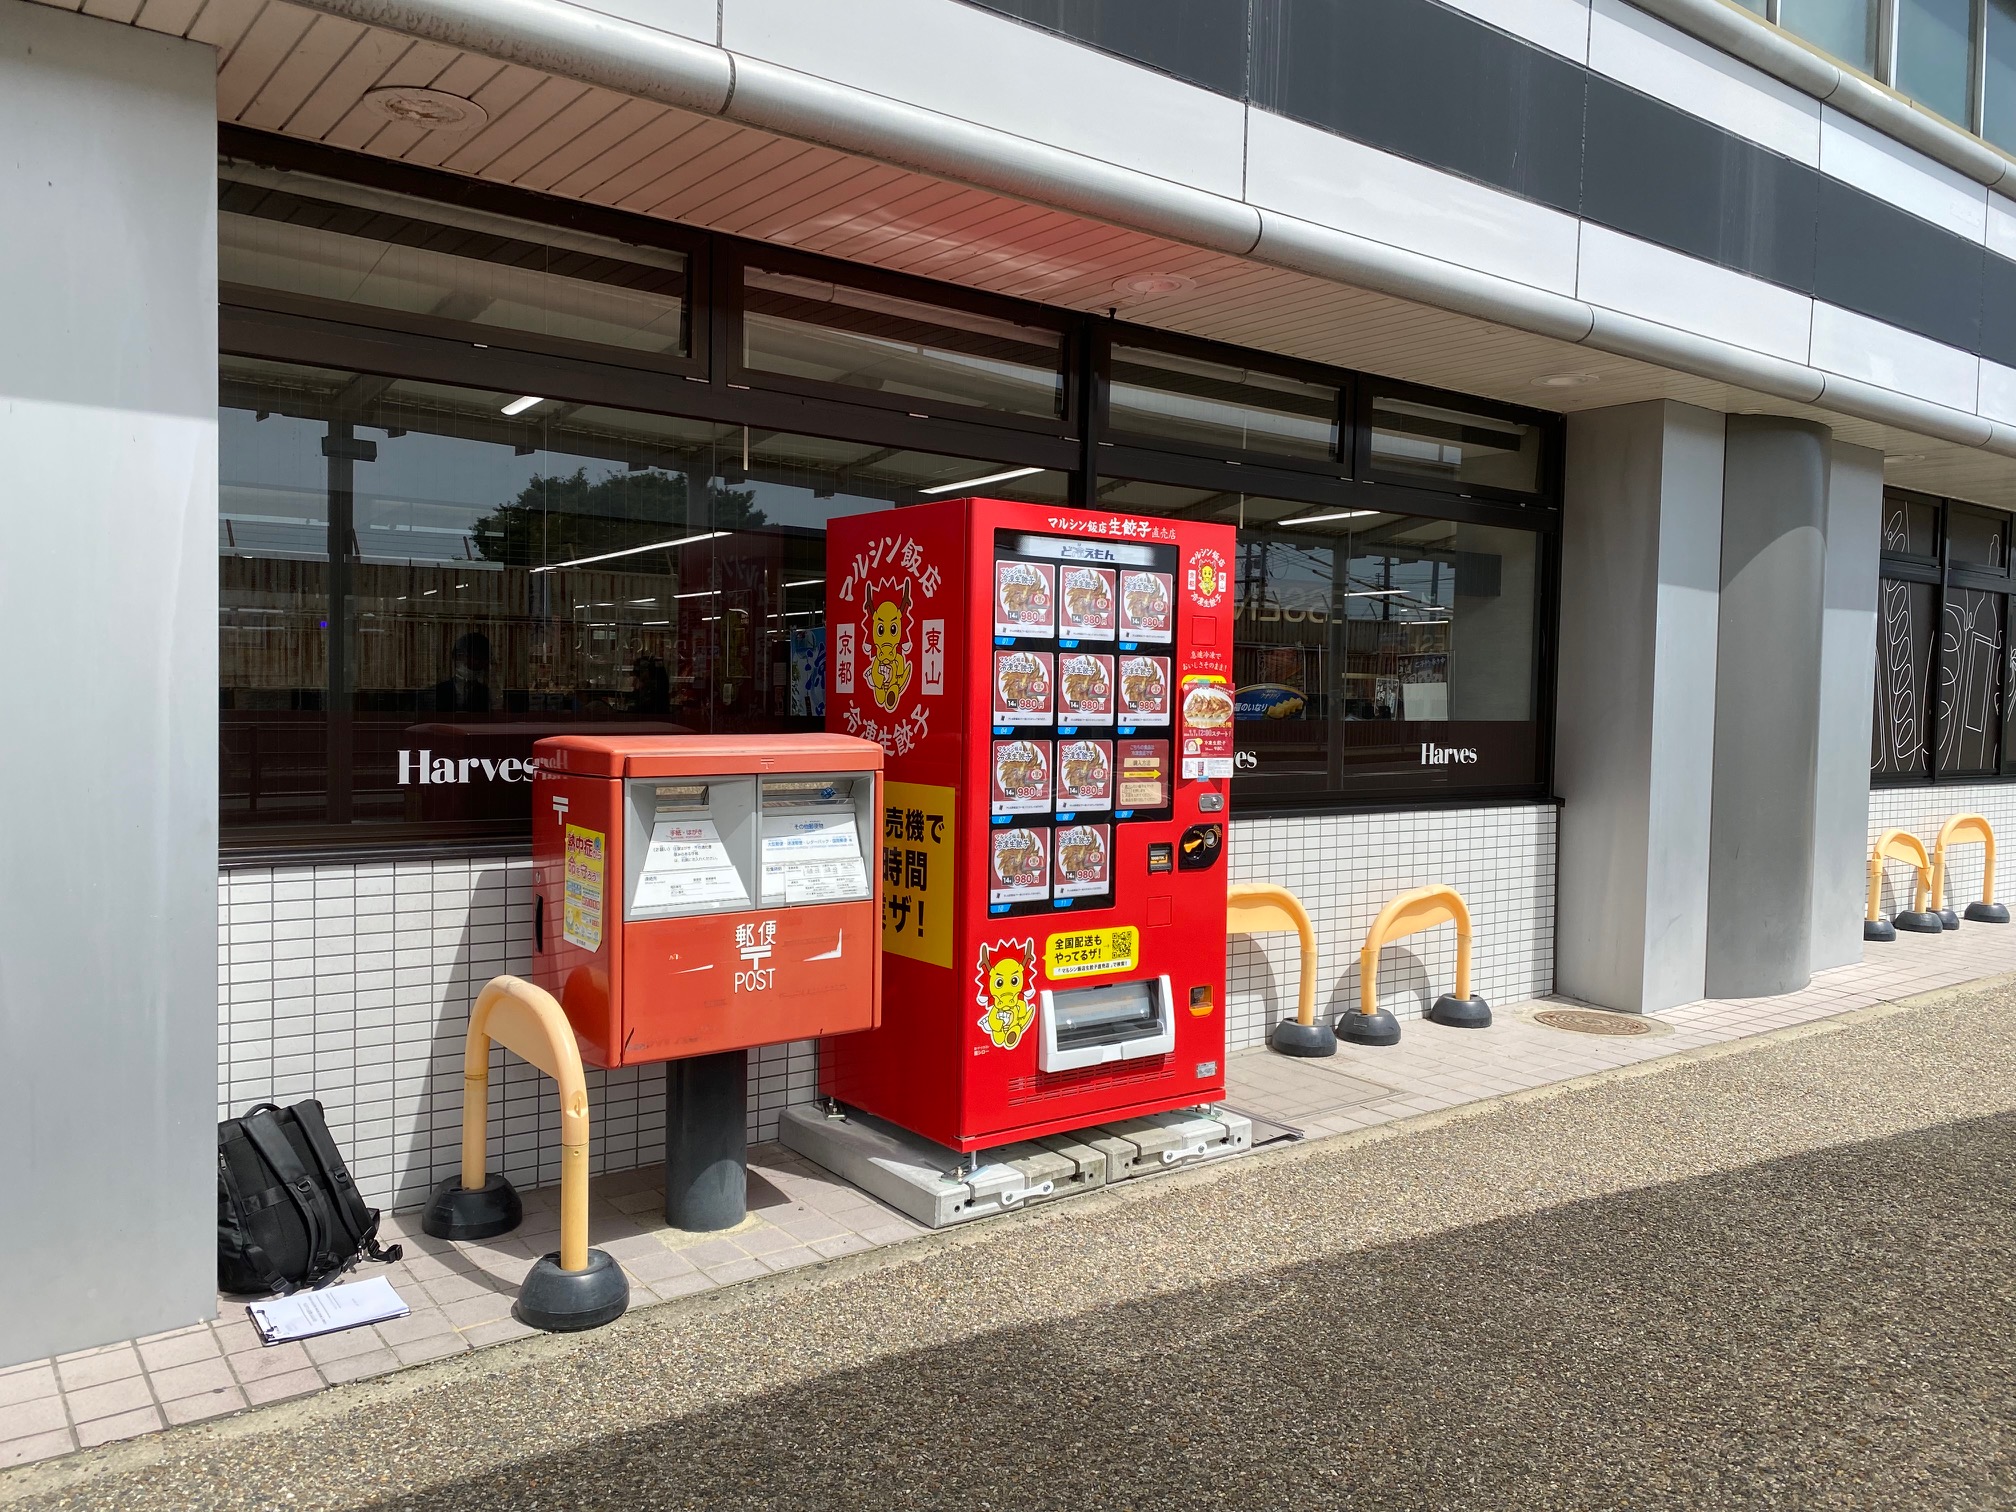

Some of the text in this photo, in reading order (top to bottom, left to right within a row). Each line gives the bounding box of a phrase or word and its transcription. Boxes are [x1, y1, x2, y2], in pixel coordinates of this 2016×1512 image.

[838, 533, 942, 601] マルシン飯店
[838, 630, 853, 685] 京都
[924, 627, 942, 685] 東山
[397, 750, 534, 785] Harves
[1234, 750, 1258, 769] es
[1421, 743, 1478, 766] Harves
[885, 806, 944, 844] 売機で
[884, 847, 927, 892] 時間
[735, 920, 777, 949] 郵便
[1054, 935, 1102, 950] 全国配送も
[1054, 948, 1102, 964] やってるザ!
[734, 968, 776, 994] POST
